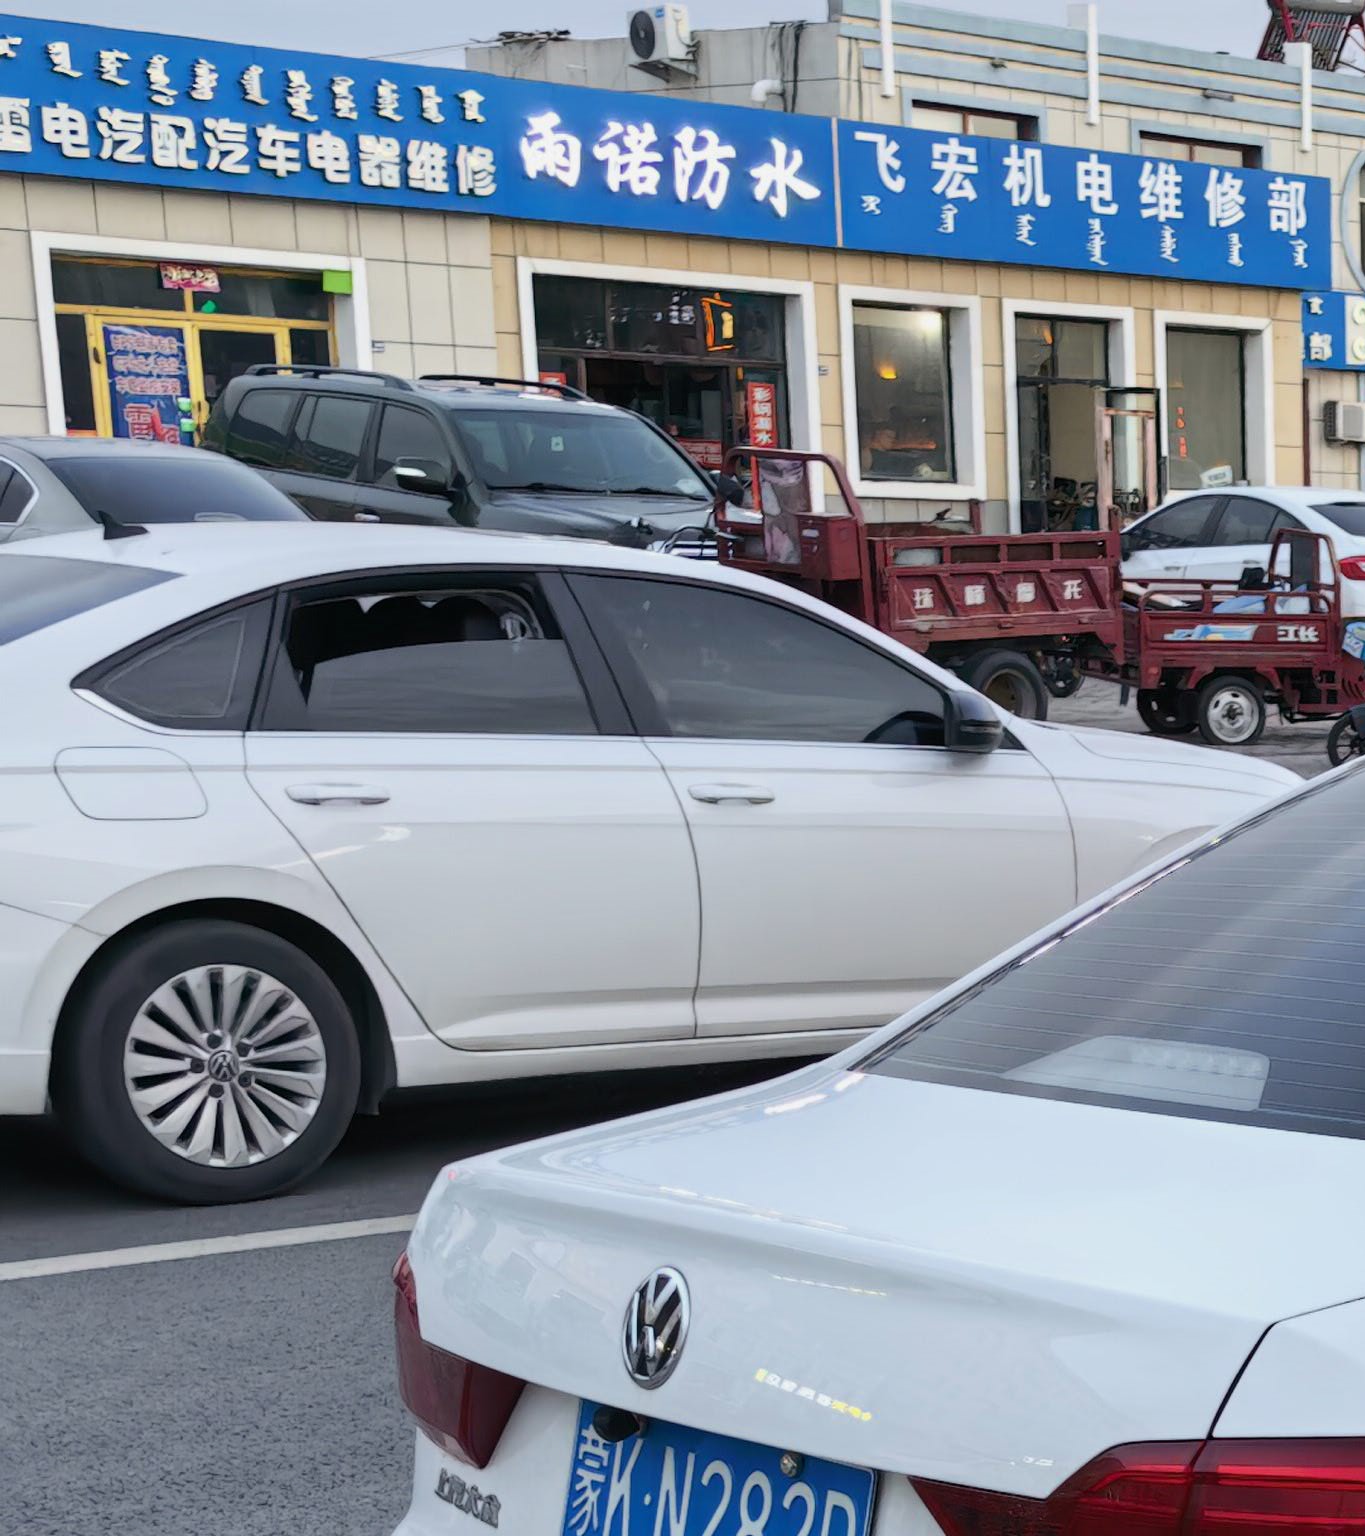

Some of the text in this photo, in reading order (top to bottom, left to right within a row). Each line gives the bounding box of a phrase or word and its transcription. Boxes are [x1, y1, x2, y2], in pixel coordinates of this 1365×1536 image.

[520, 111, 822, 218] 雨诺防水
[854, 131, 1307, 236] 飞宏机电维修部
